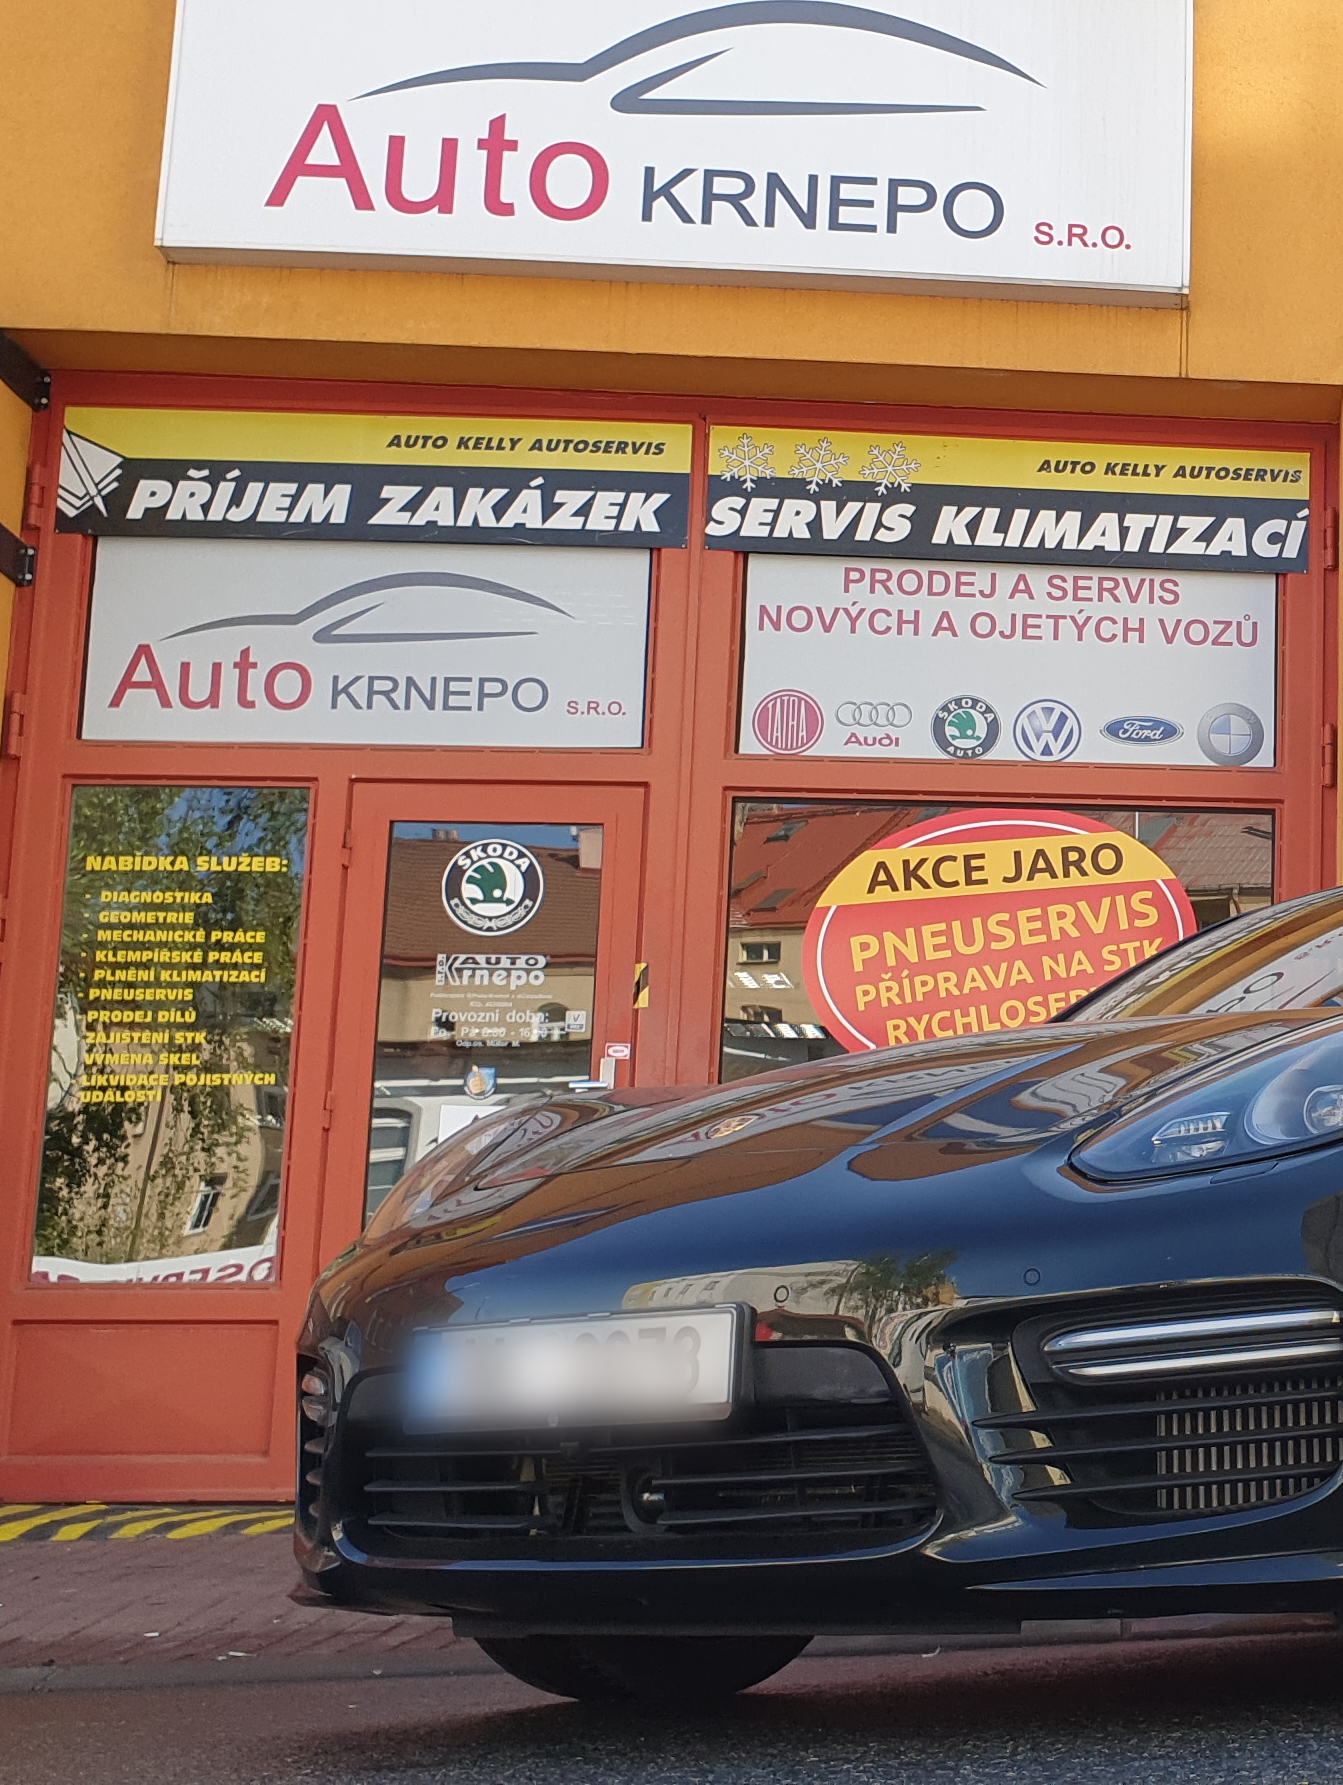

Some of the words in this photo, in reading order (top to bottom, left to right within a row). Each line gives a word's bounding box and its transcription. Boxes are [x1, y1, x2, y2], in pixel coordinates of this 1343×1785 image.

[265, 103, 611, 221] Auto
[641, 166, 1006, 240] KRNEPO
[1033, 222, 1132, 250] S.R.O.
[387, 434, 447, 450] AUTO
[455, 436, 521, 452] KELLY
[528, 437, 666, 456] AUTOSERVIS
[1036, 459, 1097, 476] AUTO
[1104, 462, 1167, 478] KELLY
[1172, 465, 1303, 483] AUTOSERVIS
[126, 469, 351, 524] PŘÍJEM
[367, 477, 671, 533] ZAKÁZEK
[705, 496, 916, 543] SERVIS
[931, 506, 1309, 559] KLIMATIZACÍ
[843, 566, 998, 600] PRODEJ
[1009, 574, 1037, 600] A
[1046, 574, 1181, 605] SERVIS
[758, 601, 920, 636] NOVÝCH
[931, 610, 958, 636] A
[969, 609, 1146, 643] OJETÝCH
[1158, 614, 1259, 648] VOZŮ
[108, 643, 312, 711] Auto
[331, 674, 549, 712] KRNEPO
[566, 700, 627, 716] S.R.O.
[767, 695, 806, 749] TATRA
[1118, 720, 1165, 740] Ford
[843, 732, 900, 748] Audi
[946, 746, 984, 758] AUTO
[86, 854, 190, 872] NABÍDKA
[196, 853, 289, 872] SLUŽEB:
[866, 851, 989, 895] AKCE
[1001, 842, 1124, 884] JARO
[100, 890, 214, 904] DIAGNOSTIKA
[98, 912, 195, 924] GEOMETRIE
[96, 929, 206, 943] MECHANICKÉ
[210, 928, 267, 943] PRÁCE
[849, 890, 1160, 972] PNEUSERVIS
[95, 949, 203, 964] KLEMPÍŘSKÉ
[207, 949, 264, 964] PRÁCE
[459, 956, 541, 967] AUTO
[160, 968, 267, 983] KLIMATIZACÍ
[855, 961, 1034, 1011] PŘÍPRAVA
[1042, 949, 1094, 980] NA
[1102, 937, 1164, 971] STK
[88, 988, 194, 1001] PNEUSERVIS
[87, 1010, 153, 1023] PRODEJ
[157, 1007, 197, 1023] DÍLŮ
[431, 1008, 500, 1023] Provozní
[174, 1031, 207, 1044] STK
[158, 1053, 201, 1065] SKEL
[81, 1073, 169, 1086] LIKVIDACE
[174, 1072, 276, 1086] POJISTNÝCH
